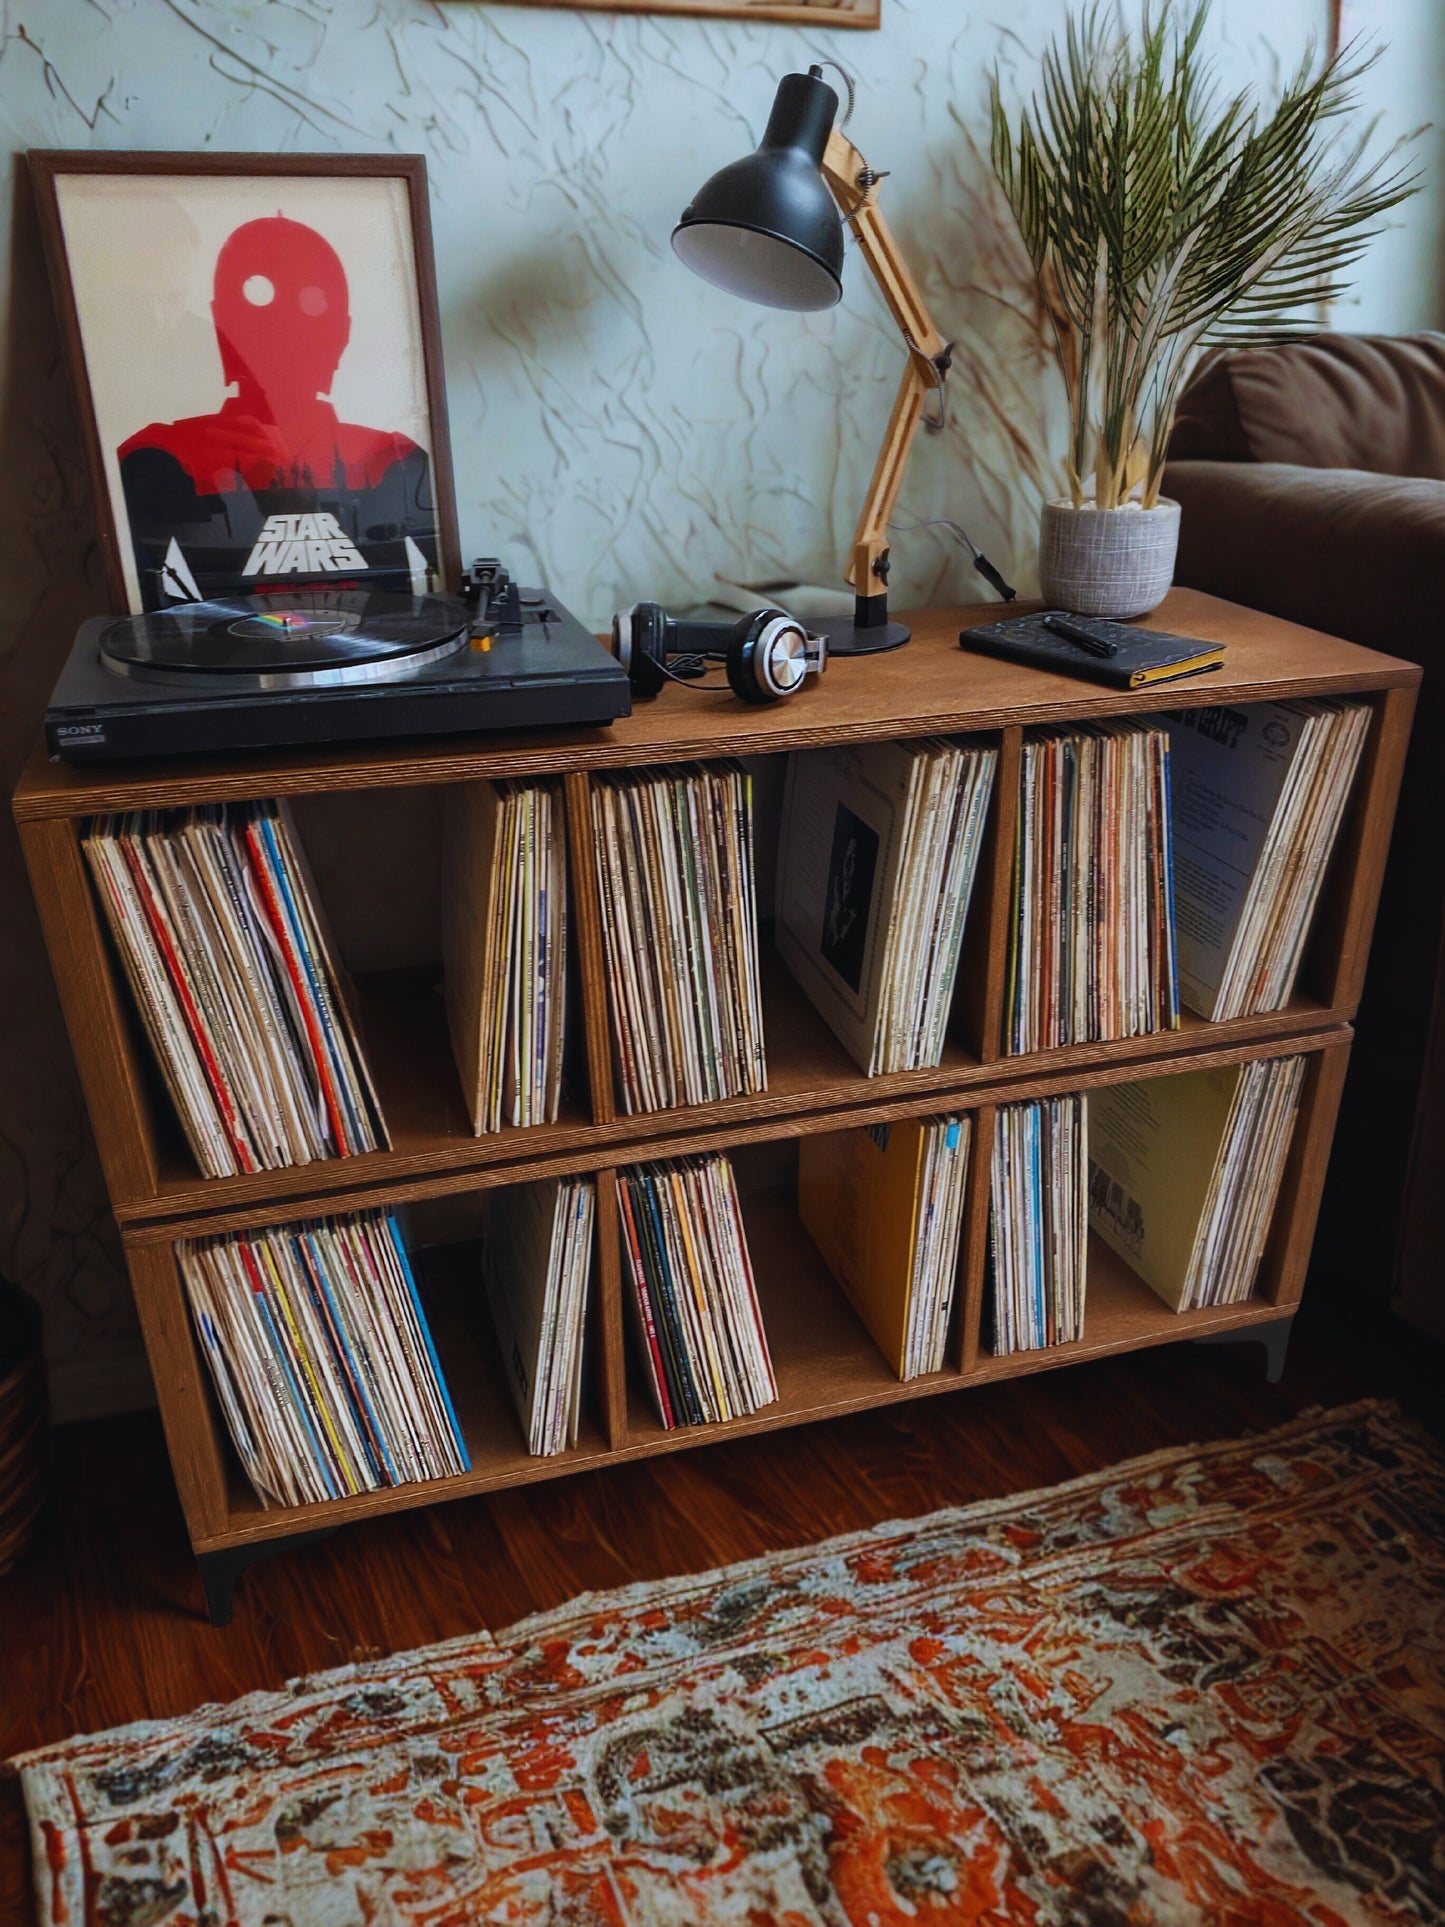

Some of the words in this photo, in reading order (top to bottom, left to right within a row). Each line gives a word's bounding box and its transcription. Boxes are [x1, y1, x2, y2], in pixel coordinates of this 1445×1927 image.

[258, 512, 348, 542] STAR
[241, 539, 369, 576] WARS
[57, 724, 103, 736] SONY
